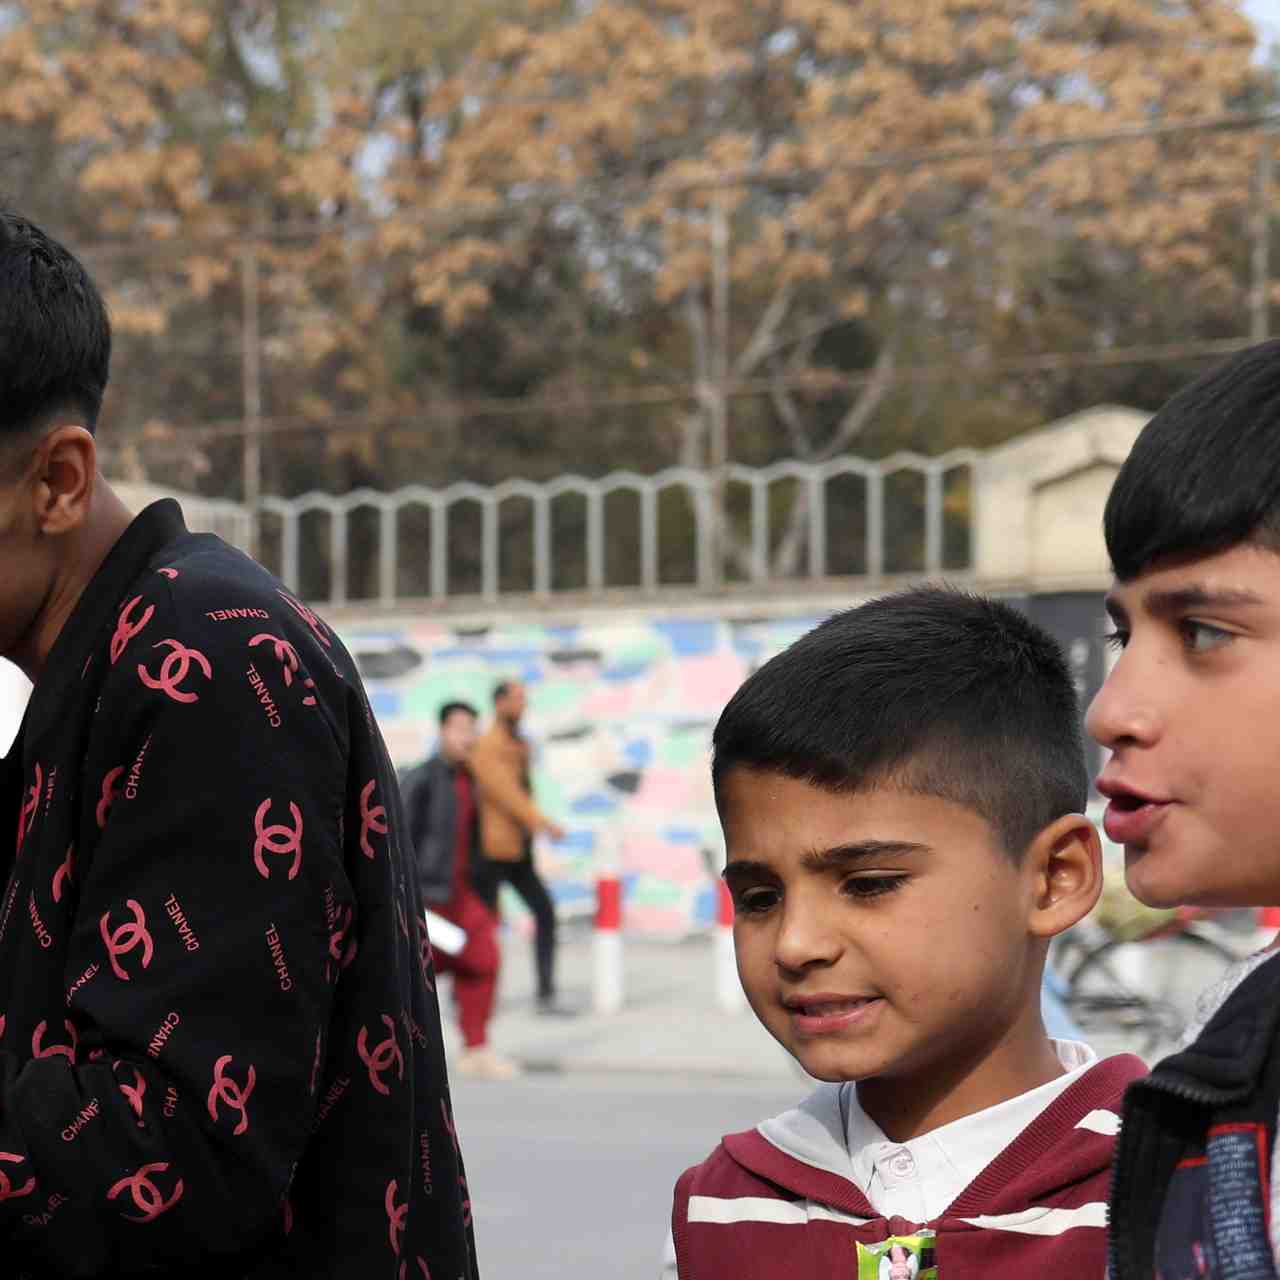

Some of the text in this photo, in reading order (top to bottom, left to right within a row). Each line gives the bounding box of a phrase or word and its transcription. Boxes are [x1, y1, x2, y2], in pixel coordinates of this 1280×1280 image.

[204, 607, 270, 622] CHANEL
[246, 662, 282, 728] CHANEL
[163, 891, 201, 953] CHANEL
[265, 921, 293, 992] CHANEL
[60, 1098, 101, 1143] CHANE
